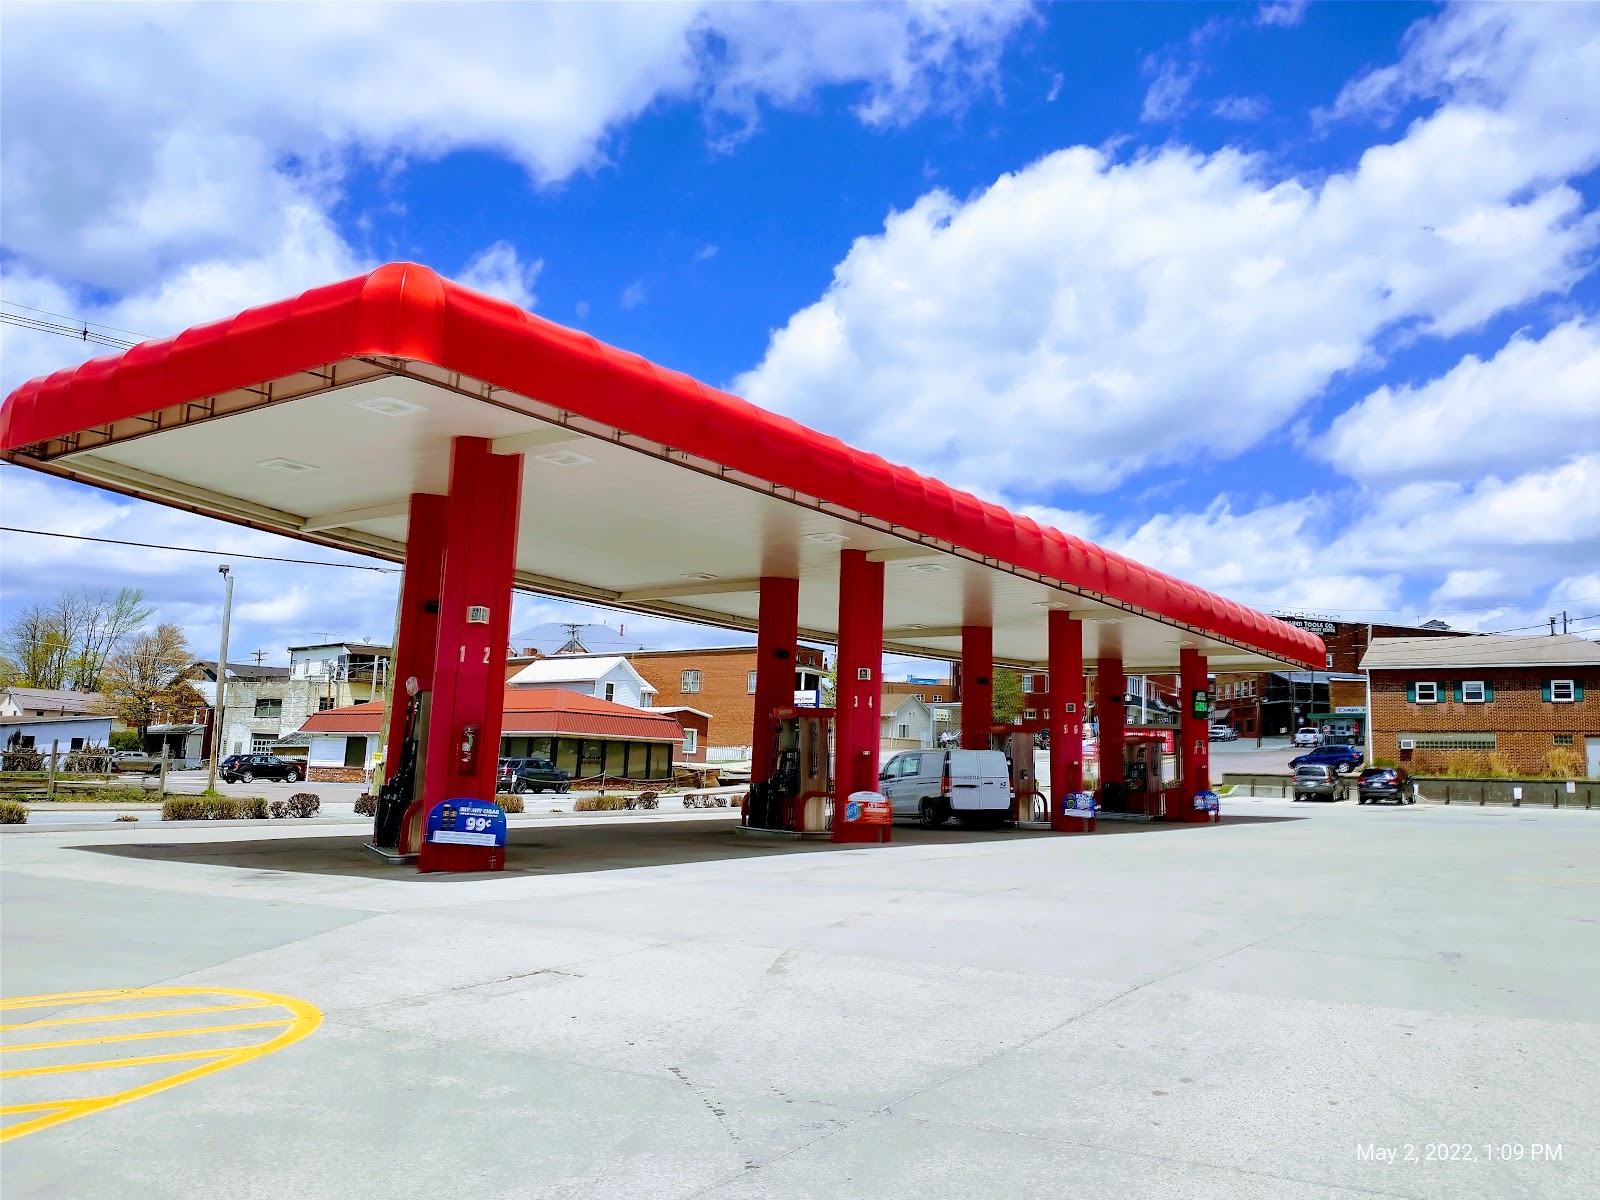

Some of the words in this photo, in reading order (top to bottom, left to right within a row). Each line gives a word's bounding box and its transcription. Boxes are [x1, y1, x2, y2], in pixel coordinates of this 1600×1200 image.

[460, 645, 466, 663] 1
[482, 646, 491, 664] 2
[853, 695, 859, 708] 3
[868, 695, 873, 709] 4
